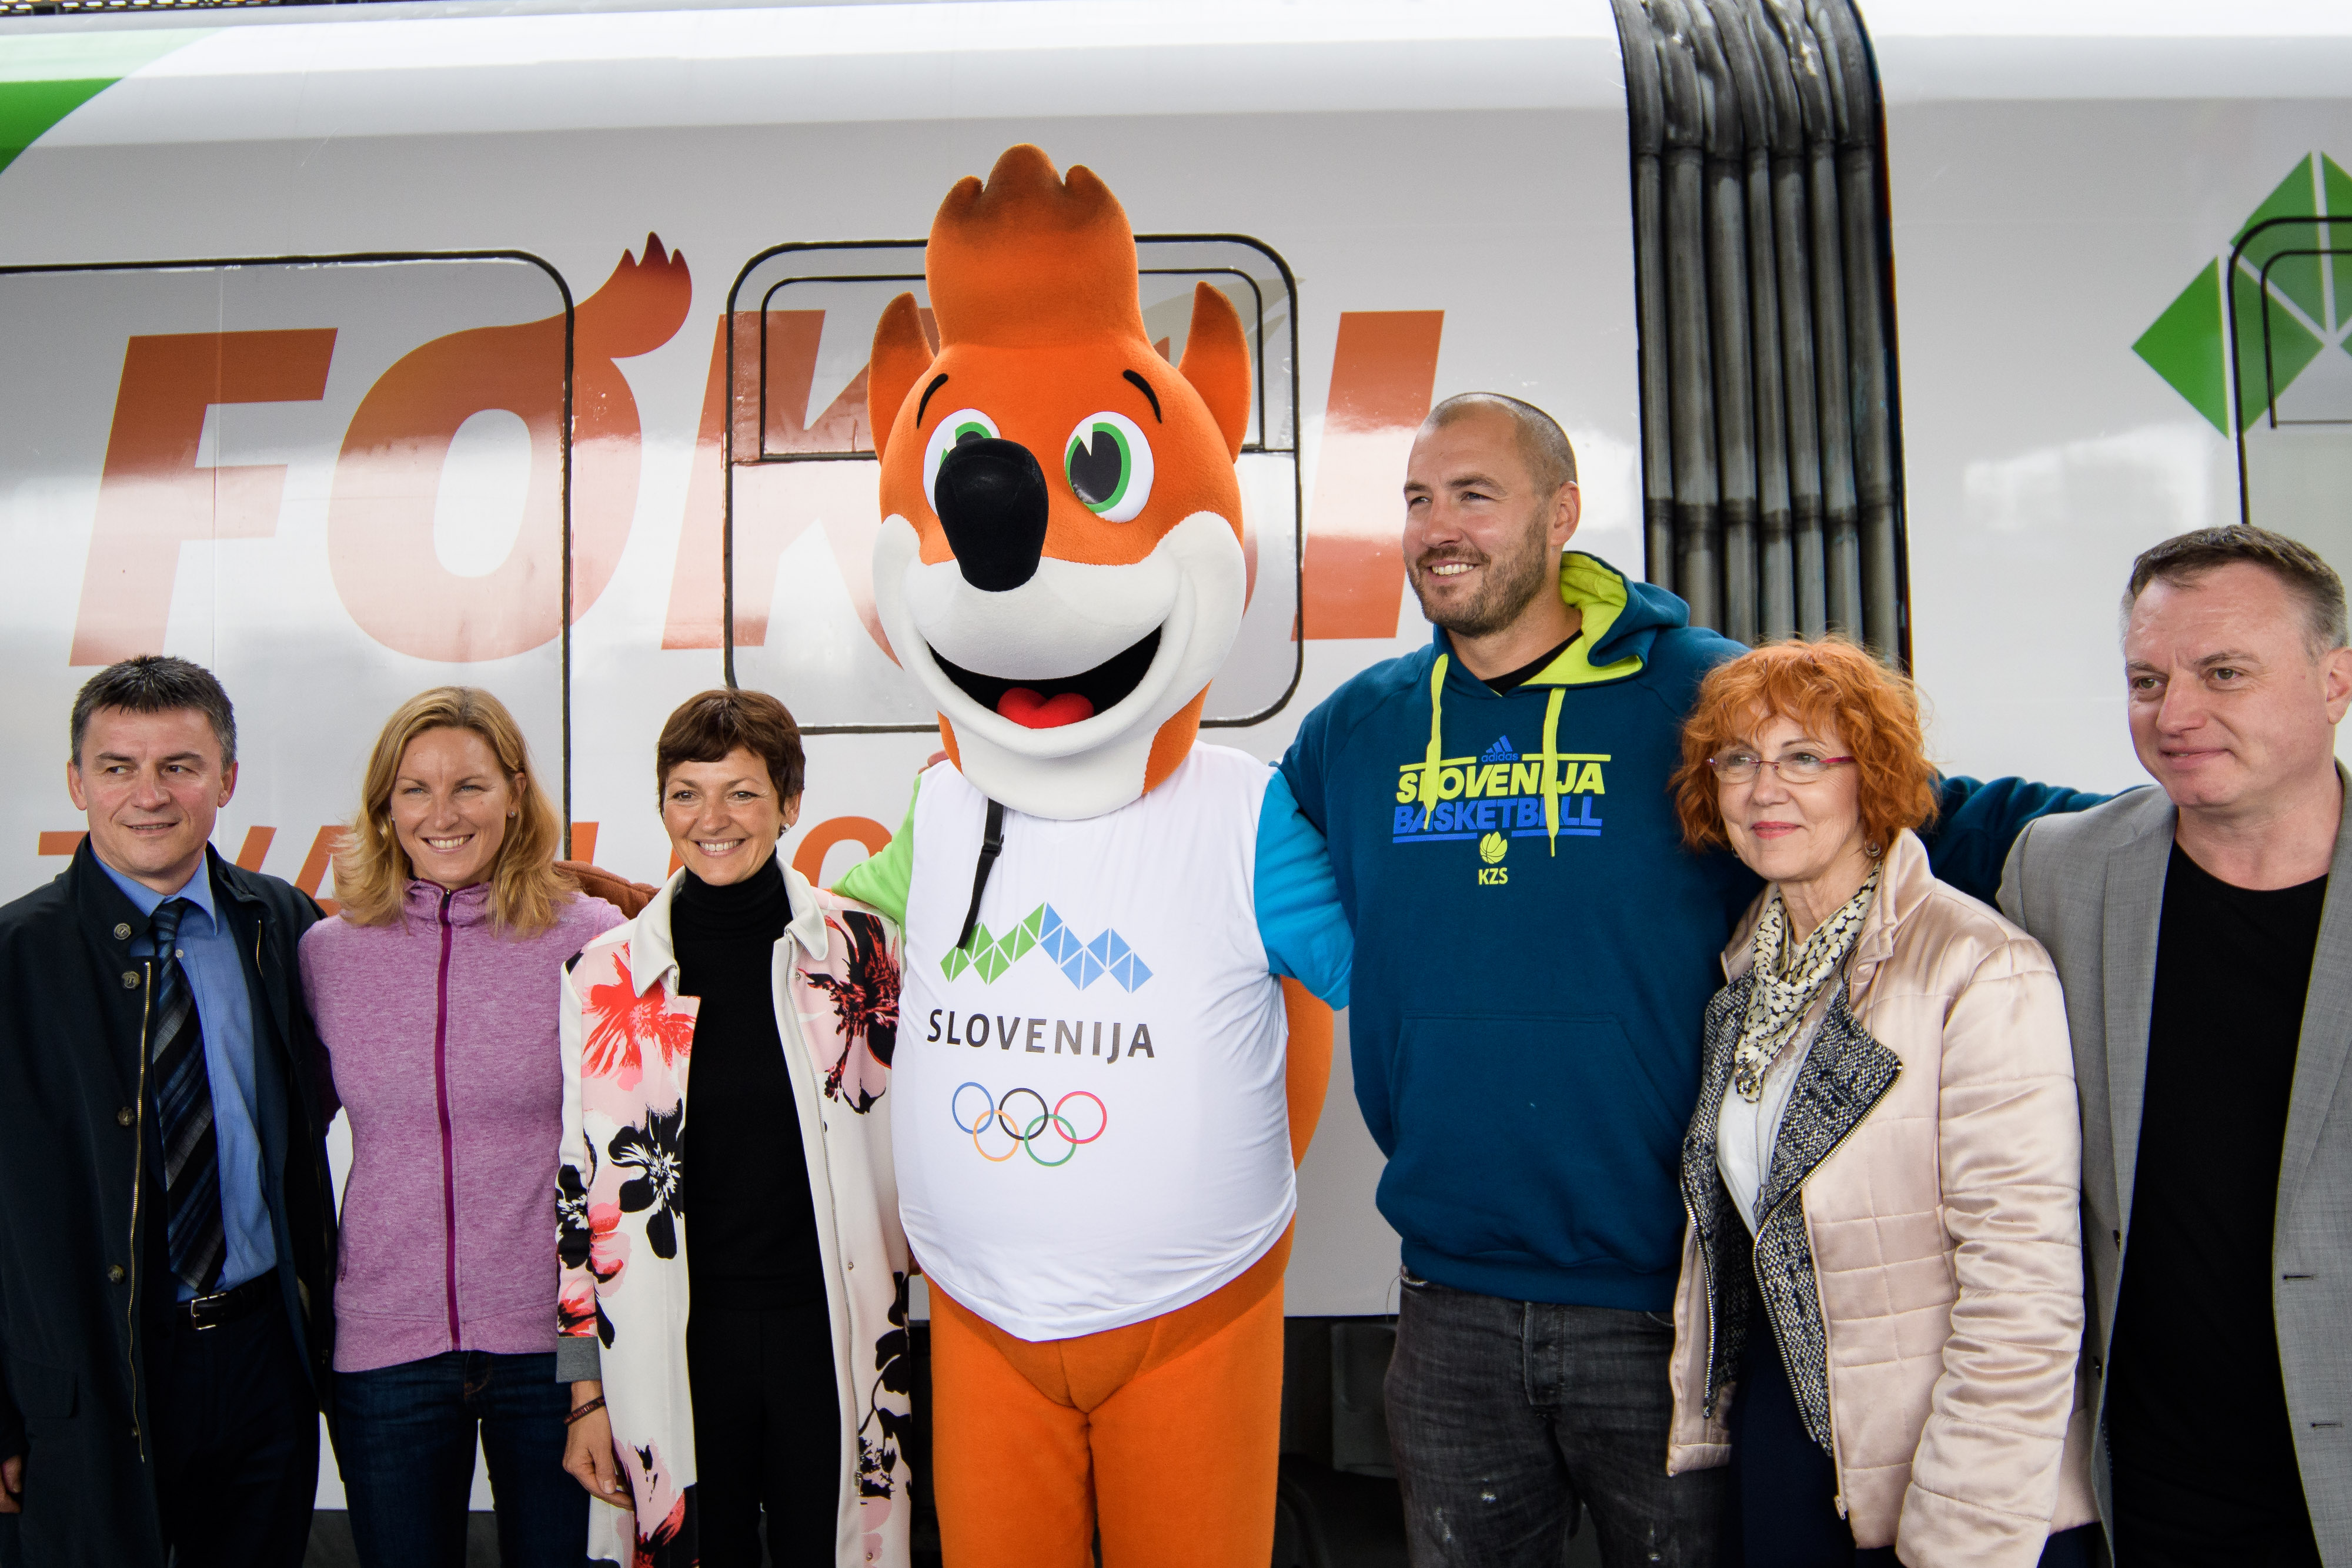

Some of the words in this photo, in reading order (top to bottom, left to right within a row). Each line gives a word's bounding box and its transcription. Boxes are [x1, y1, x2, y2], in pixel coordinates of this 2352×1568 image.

[69, 232, 1445, 670] FOKI
[1481, 751, 1518, 763] adidas
[1478, 867, 1508, 885] KZS
[927, 1009, 1154, 1064] SLOVENIJA
